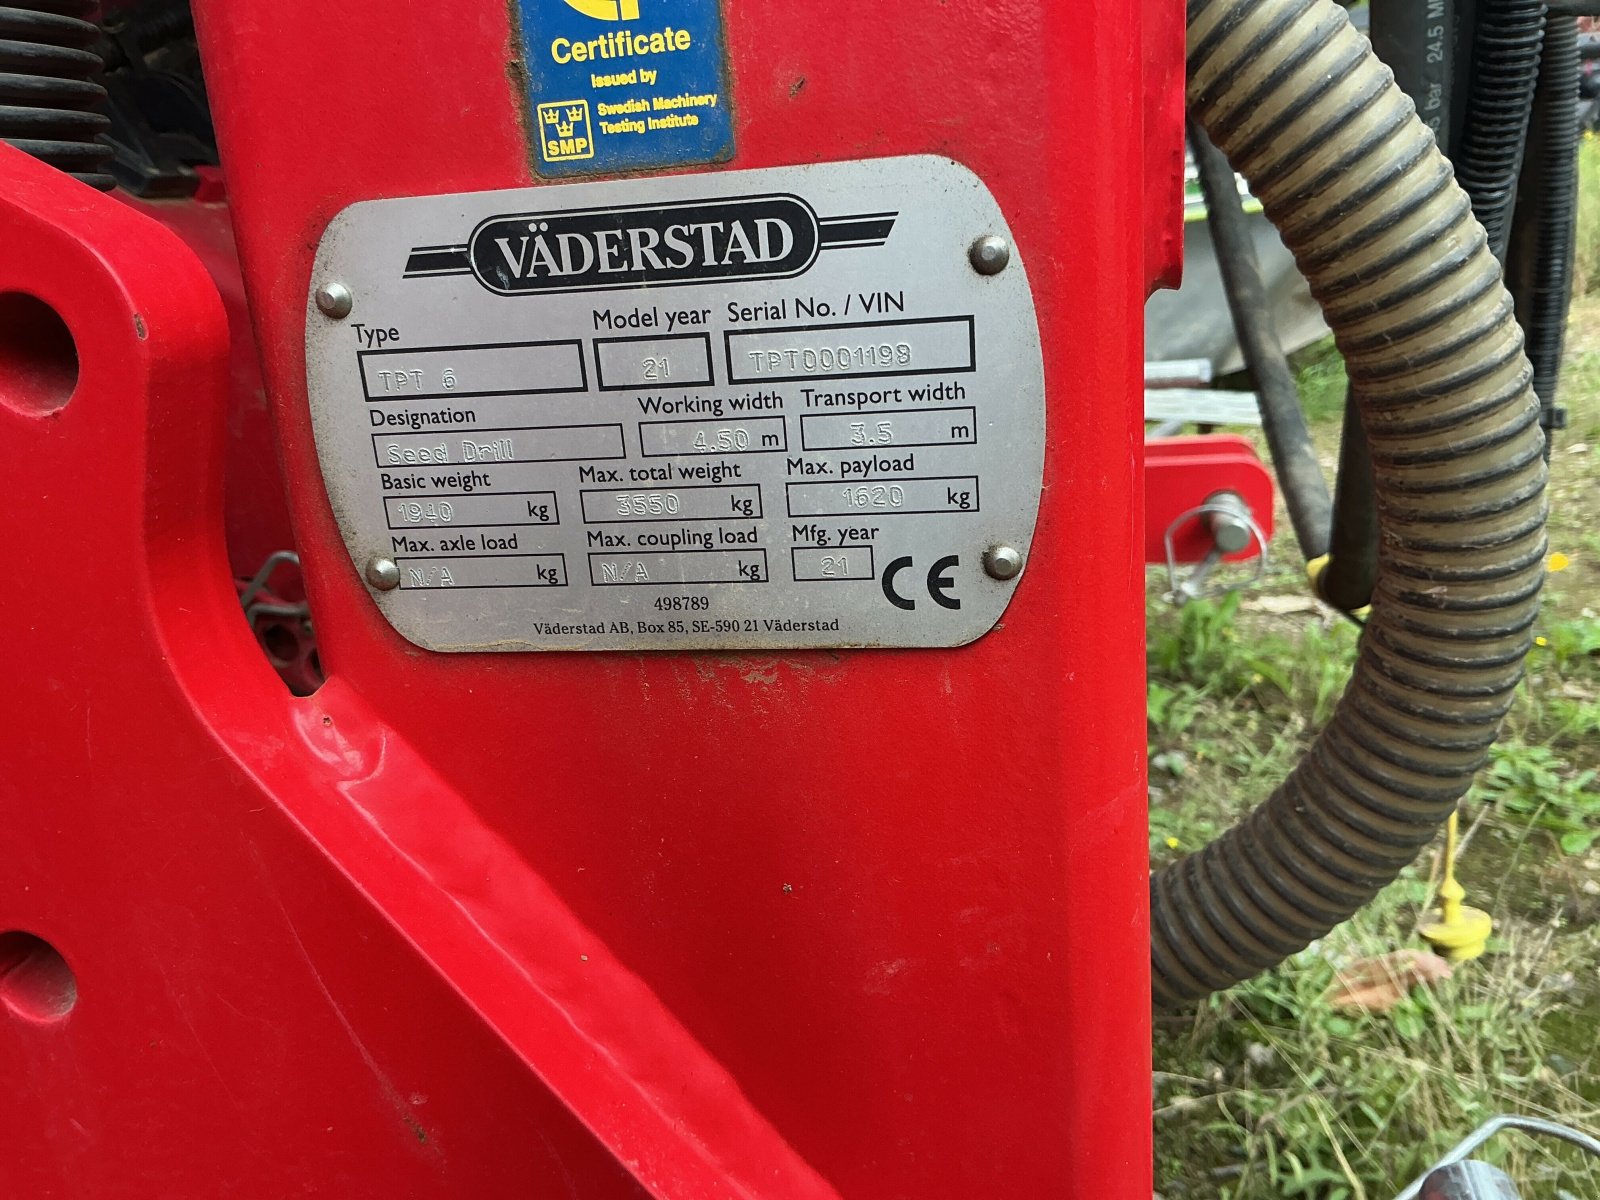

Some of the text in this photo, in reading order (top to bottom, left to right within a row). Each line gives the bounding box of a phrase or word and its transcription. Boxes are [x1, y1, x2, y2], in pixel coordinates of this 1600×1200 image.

[1426, 0, 1444, 19] M
[551, 27, 691, 64] Certificate
[1426, 25, 1444, 64] 24.5
[591, 68, 657, 88] Issued by
[597, 92, 718, 116] Swedish Machinery
[1424, 82, 1442, 111] bar
[599, 114, 699, 134] Testing Institute
[547, 137, 588, 156] SMP
[494, 218, 794, 279] VÄDERSTAD
[728, 291, 904, 322] Serial No. / VIN
[593, 306, 711, 332] Model year
[351, 324, 400, 348] Type
[378, 369, 425, 393] TPT
[641, 357, 671, 381] 21
[637, 391, 784, 417] Working width
[800, 382, 966, 410] Transport width
[369, 407, 476, 430] Designation
[692, 428, 779, 453] 4.50 m
[849, 421, 970, 446] 3.5 m
[386, 438, 515, 465] Seed Drill
[579, 461, 742, 483] Max. total weight
[787, 453, 915, 478] Max. payload
[380, 470, 492, 492] Basic weight
[615, 493, 753, 517] 3550 kg
[842, 484, 970, 509] 1620 kg
[398, 500, 550, 524] 1940 kg
[392, 532, 519, 553] Max. axle load
[587, 526, 758, 550] Max. coupling load
[792, 524, 880, 546] Mfg. year
[408, 564, 559, 588] N/A kg
[601, 560, 761, 583] N/A kg
[820, 556, 850, 576] 21
[654, 596, 710, 611] 498789
[533, 617, 840, 636] Väderstad AB, Box 85, SE-590 21 Väderstad
